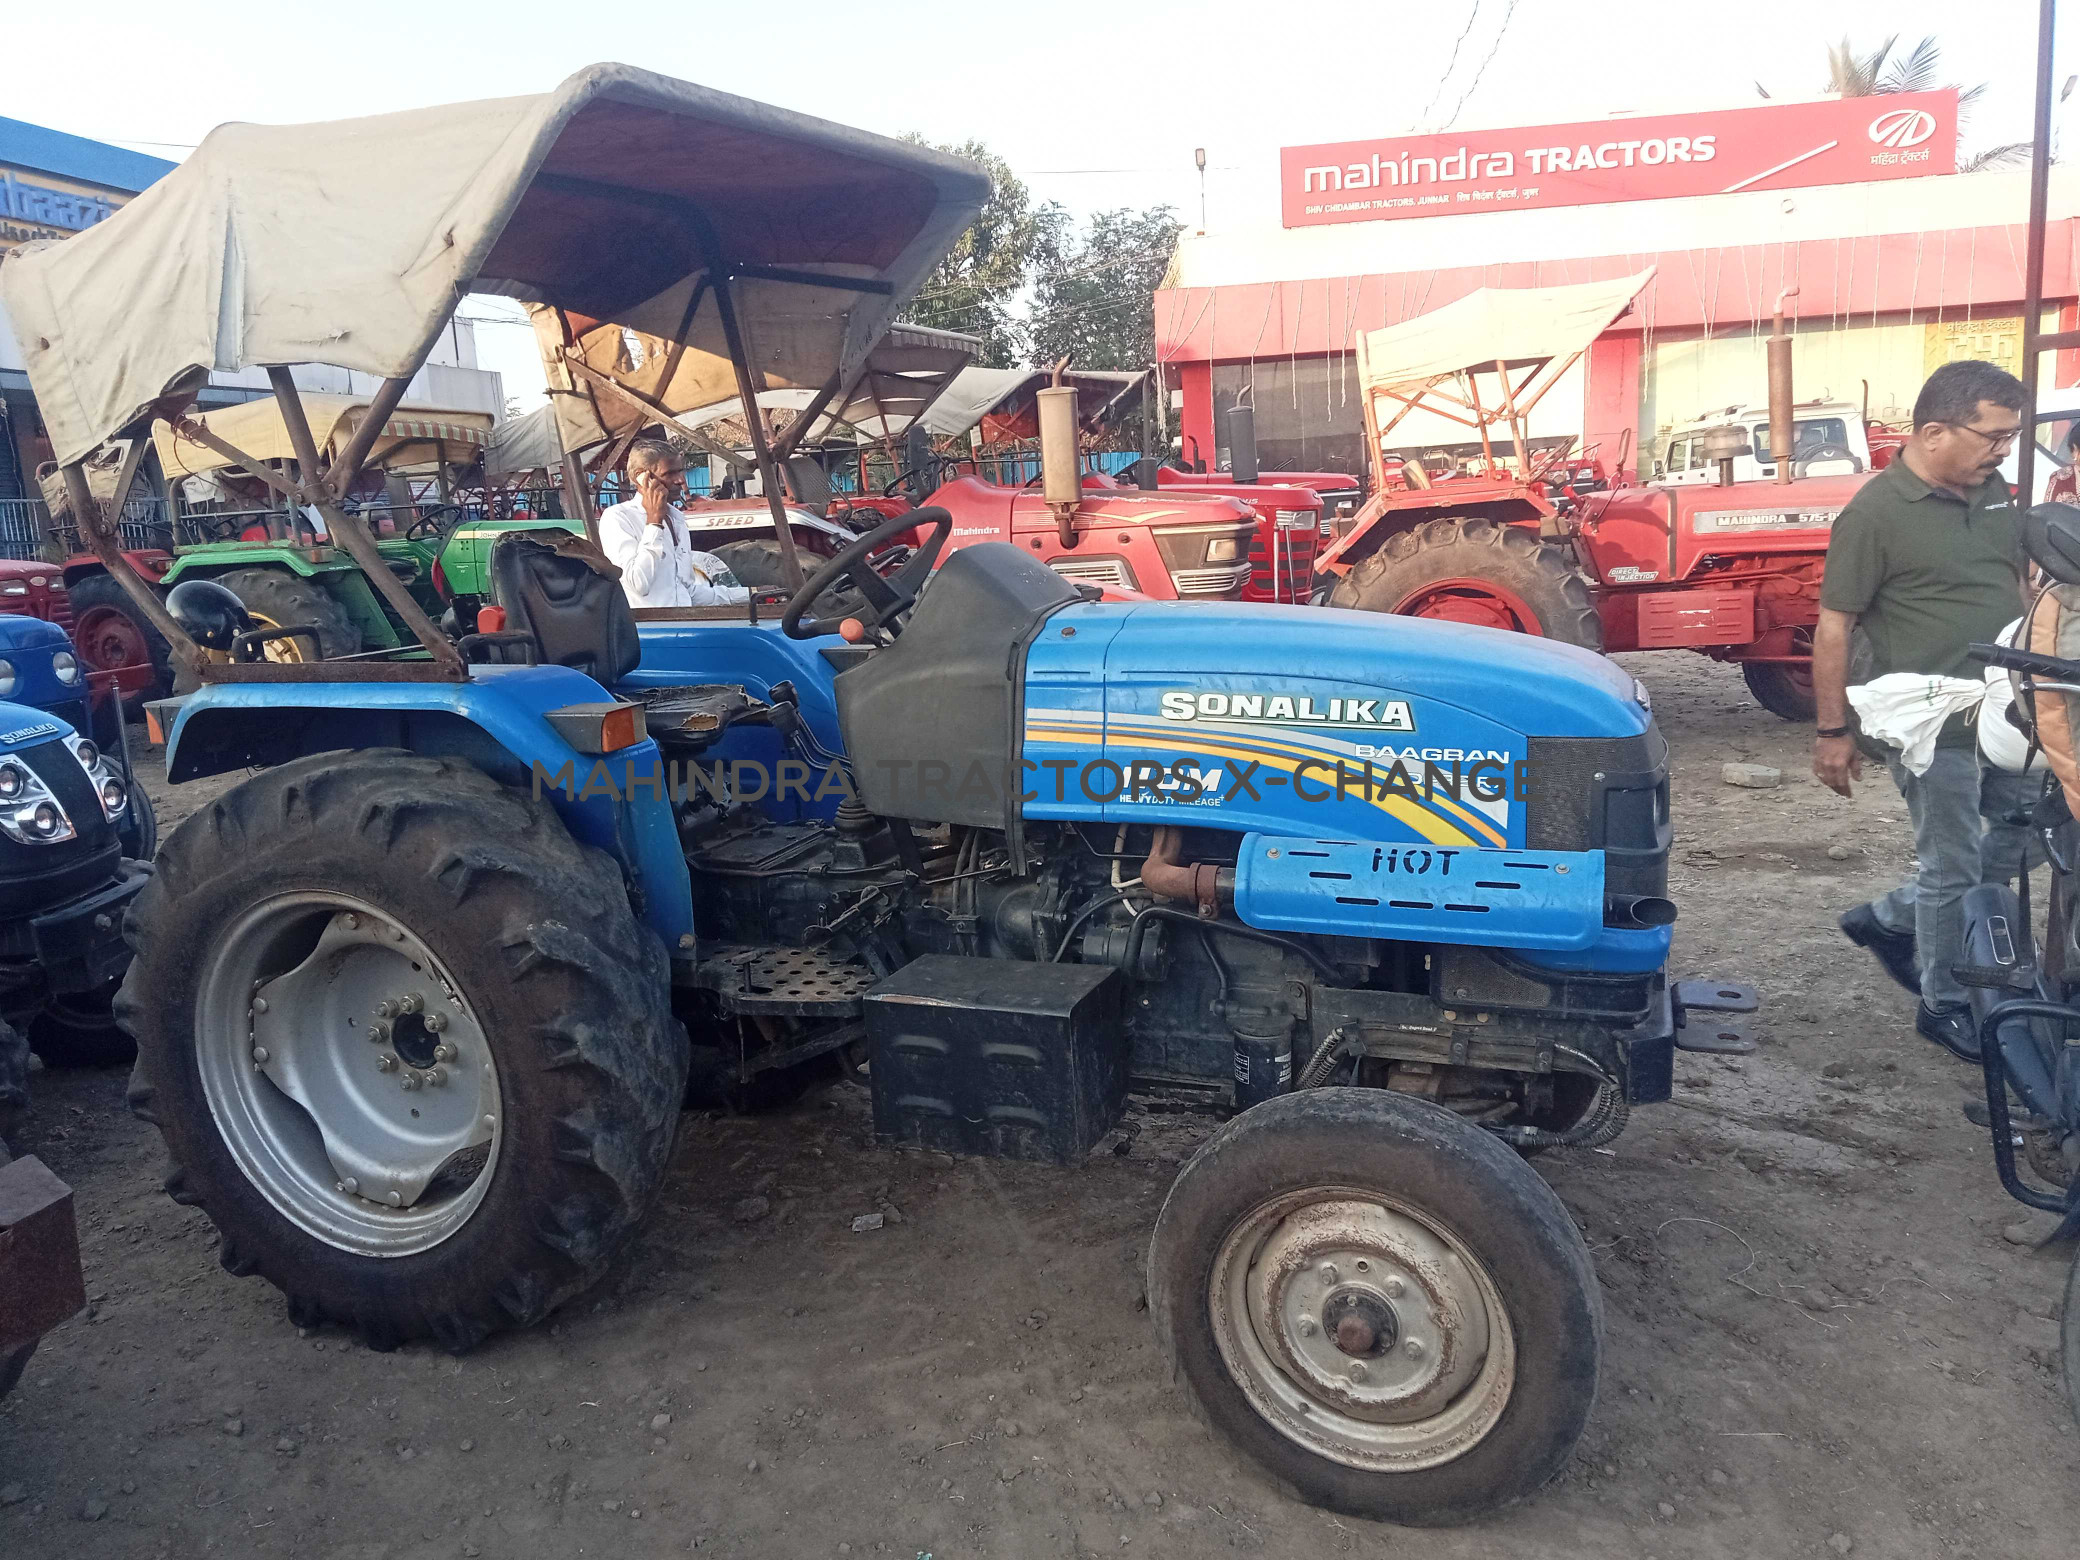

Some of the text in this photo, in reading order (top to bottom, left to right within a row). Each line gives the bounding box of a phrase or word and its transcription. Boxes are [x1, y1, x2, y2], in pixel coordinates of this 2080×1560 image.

[1304, 135, 1716, 193] mahindra TRACTORS
[1305, 205, 1323, 214] SHIV
[1324, 201, 1371, 212] CHIDAMBAR
[706, 515, 755, 528] SPEED
[1717, 512, 1841, 526] MAHINDRA 575-D
[1616, 573, 1656, 581] INJECTION
[1161, 692, 1416, 731] SONALIKA
[0, 722, 59, 744] SONALIKA
[1355, 744, 1510, 764] BAAGBAN
[1372, 847, 1460, 876] HOT
